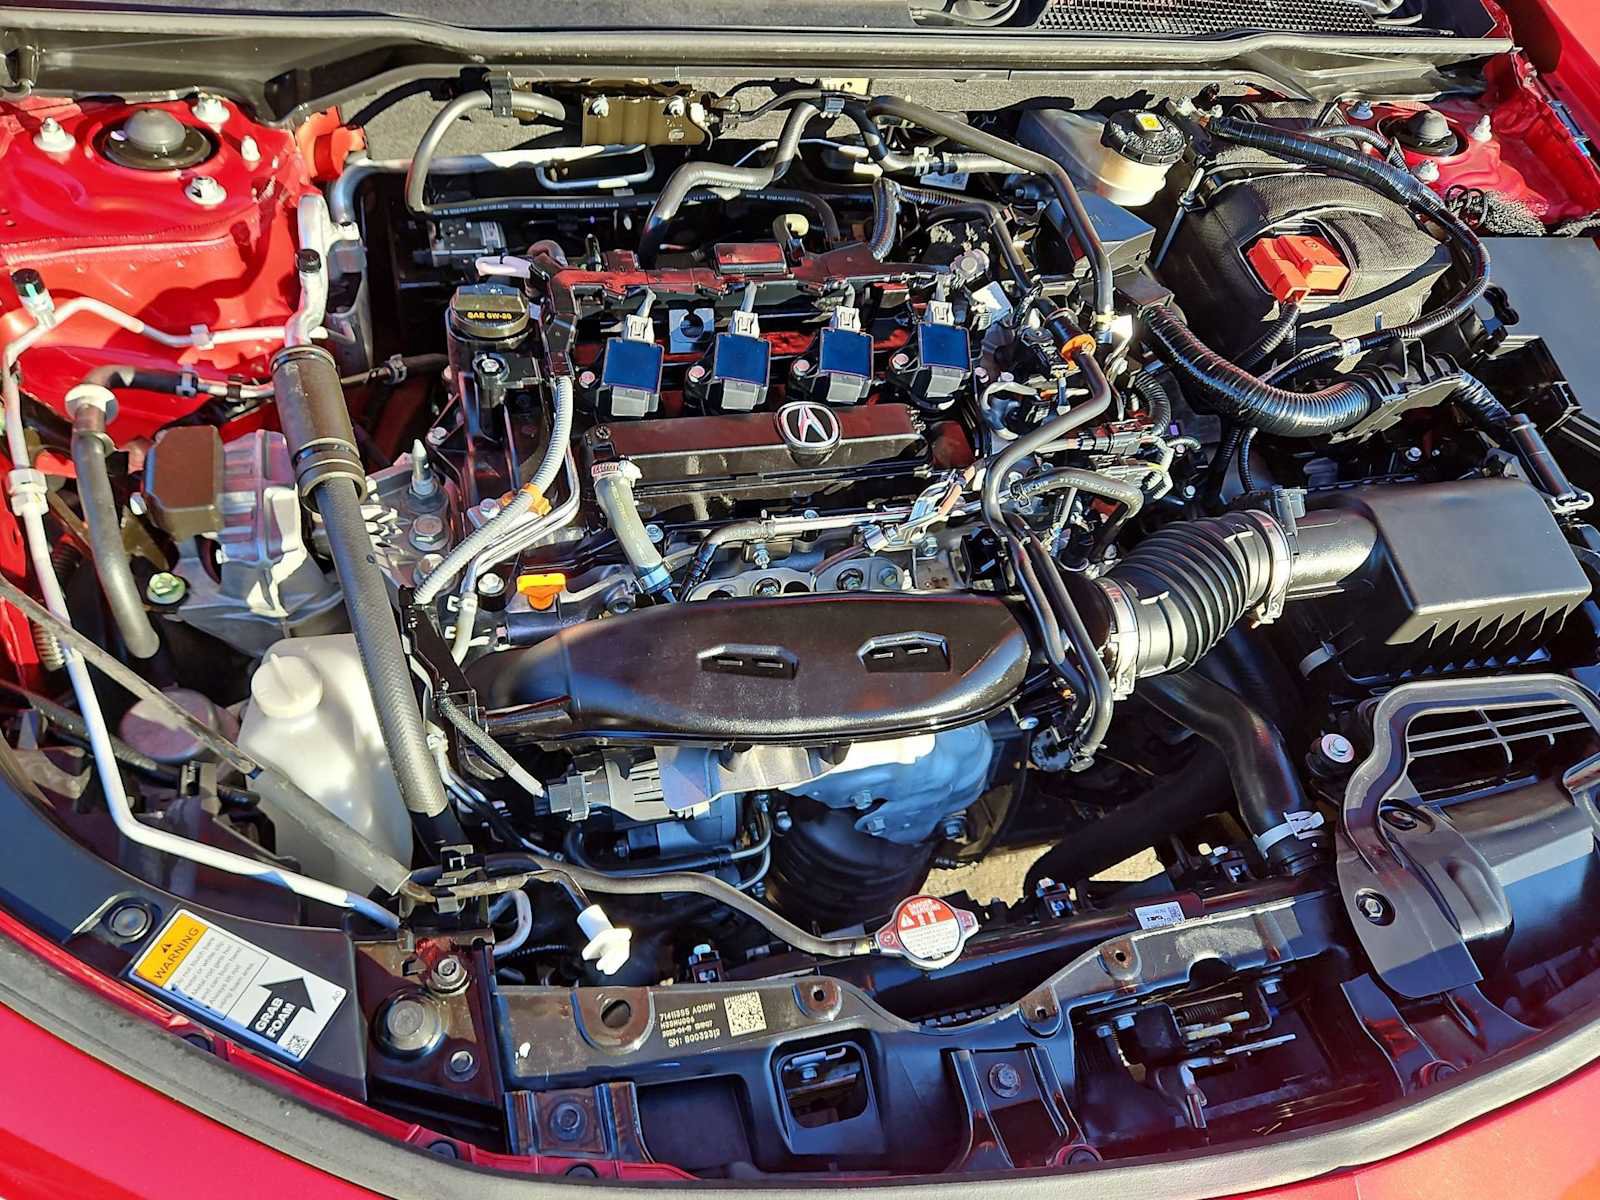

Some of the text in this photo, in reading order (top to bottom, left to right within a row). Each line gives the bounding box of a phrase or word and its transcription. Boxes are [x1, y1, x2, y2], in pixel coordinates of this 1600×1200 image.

[154, 927, 199, 979] WARNING
[254, 997, 284, 1032] GRAB
[266, 1002, 296, 1038] FOAM
